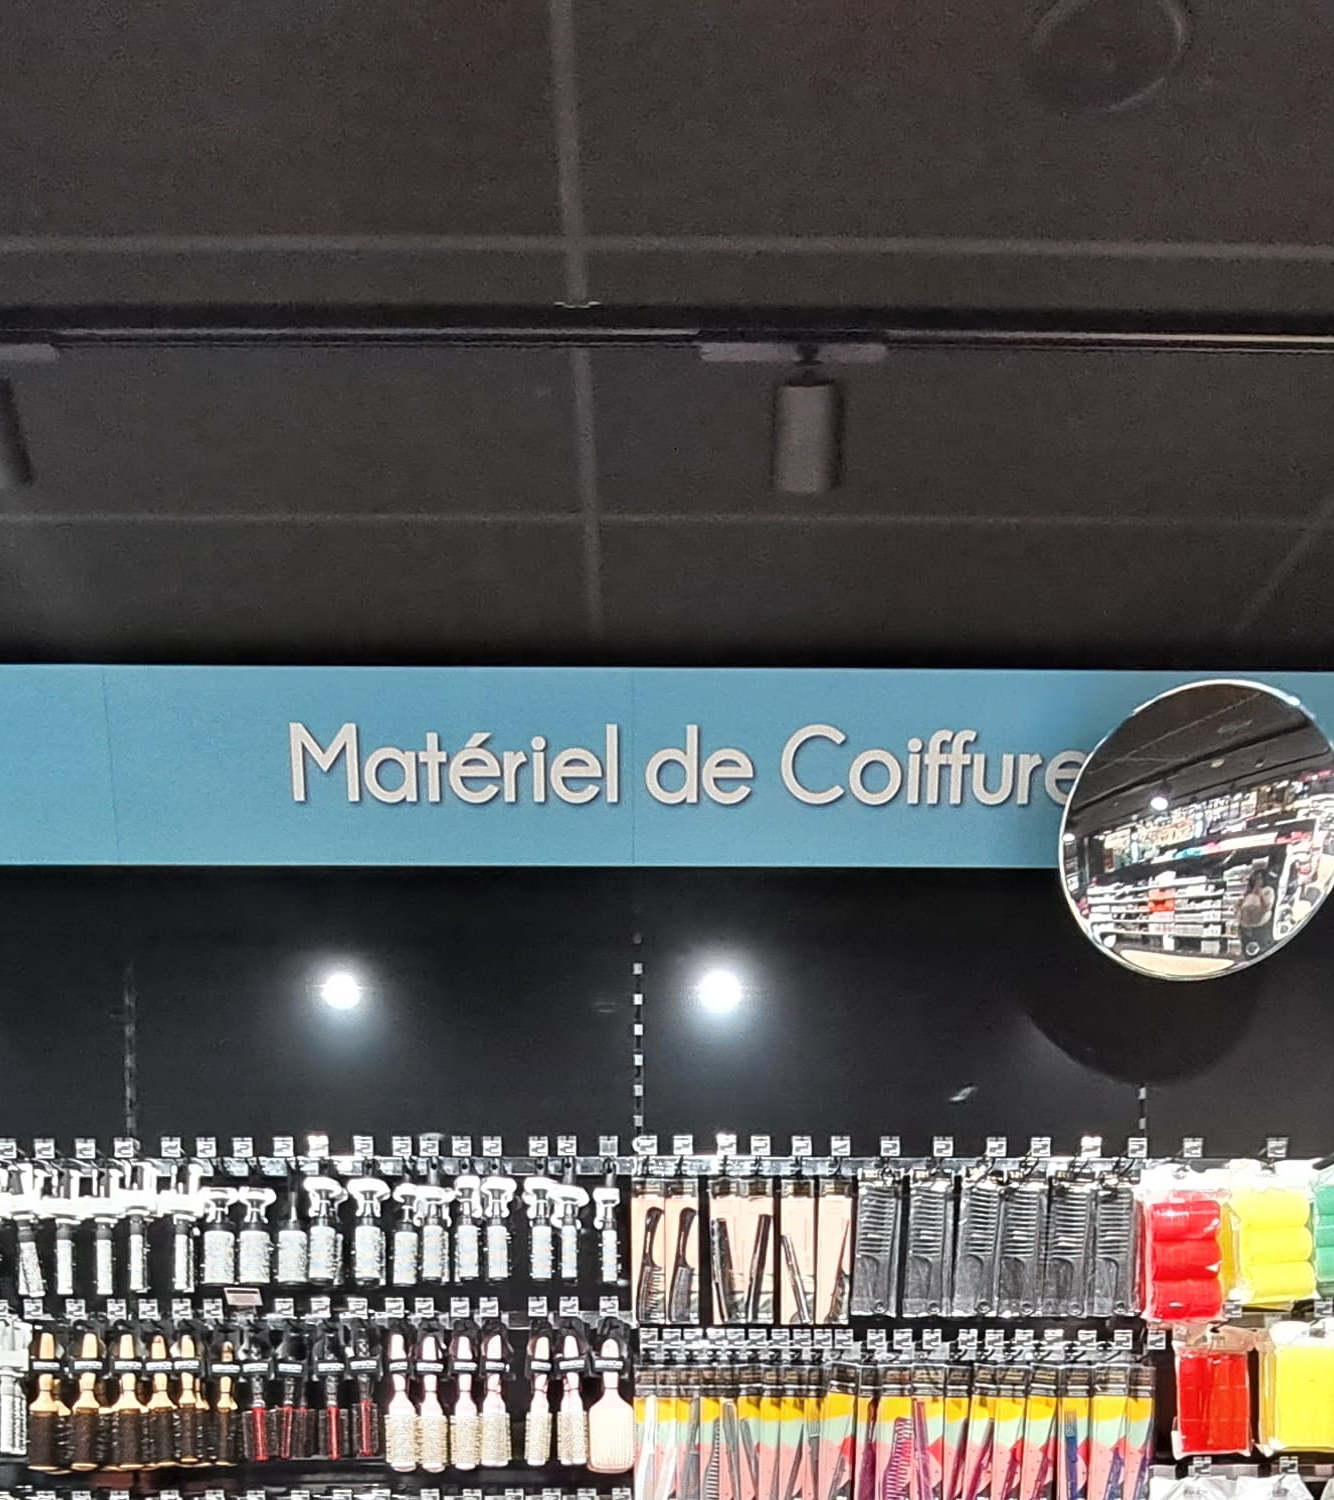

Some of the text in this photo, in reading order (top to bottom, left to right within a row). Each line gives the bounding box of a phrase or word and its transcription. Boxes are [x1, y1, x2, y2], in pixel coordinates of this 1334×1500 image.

[288, 722, 1088, 805] Matériel de Coiffure
